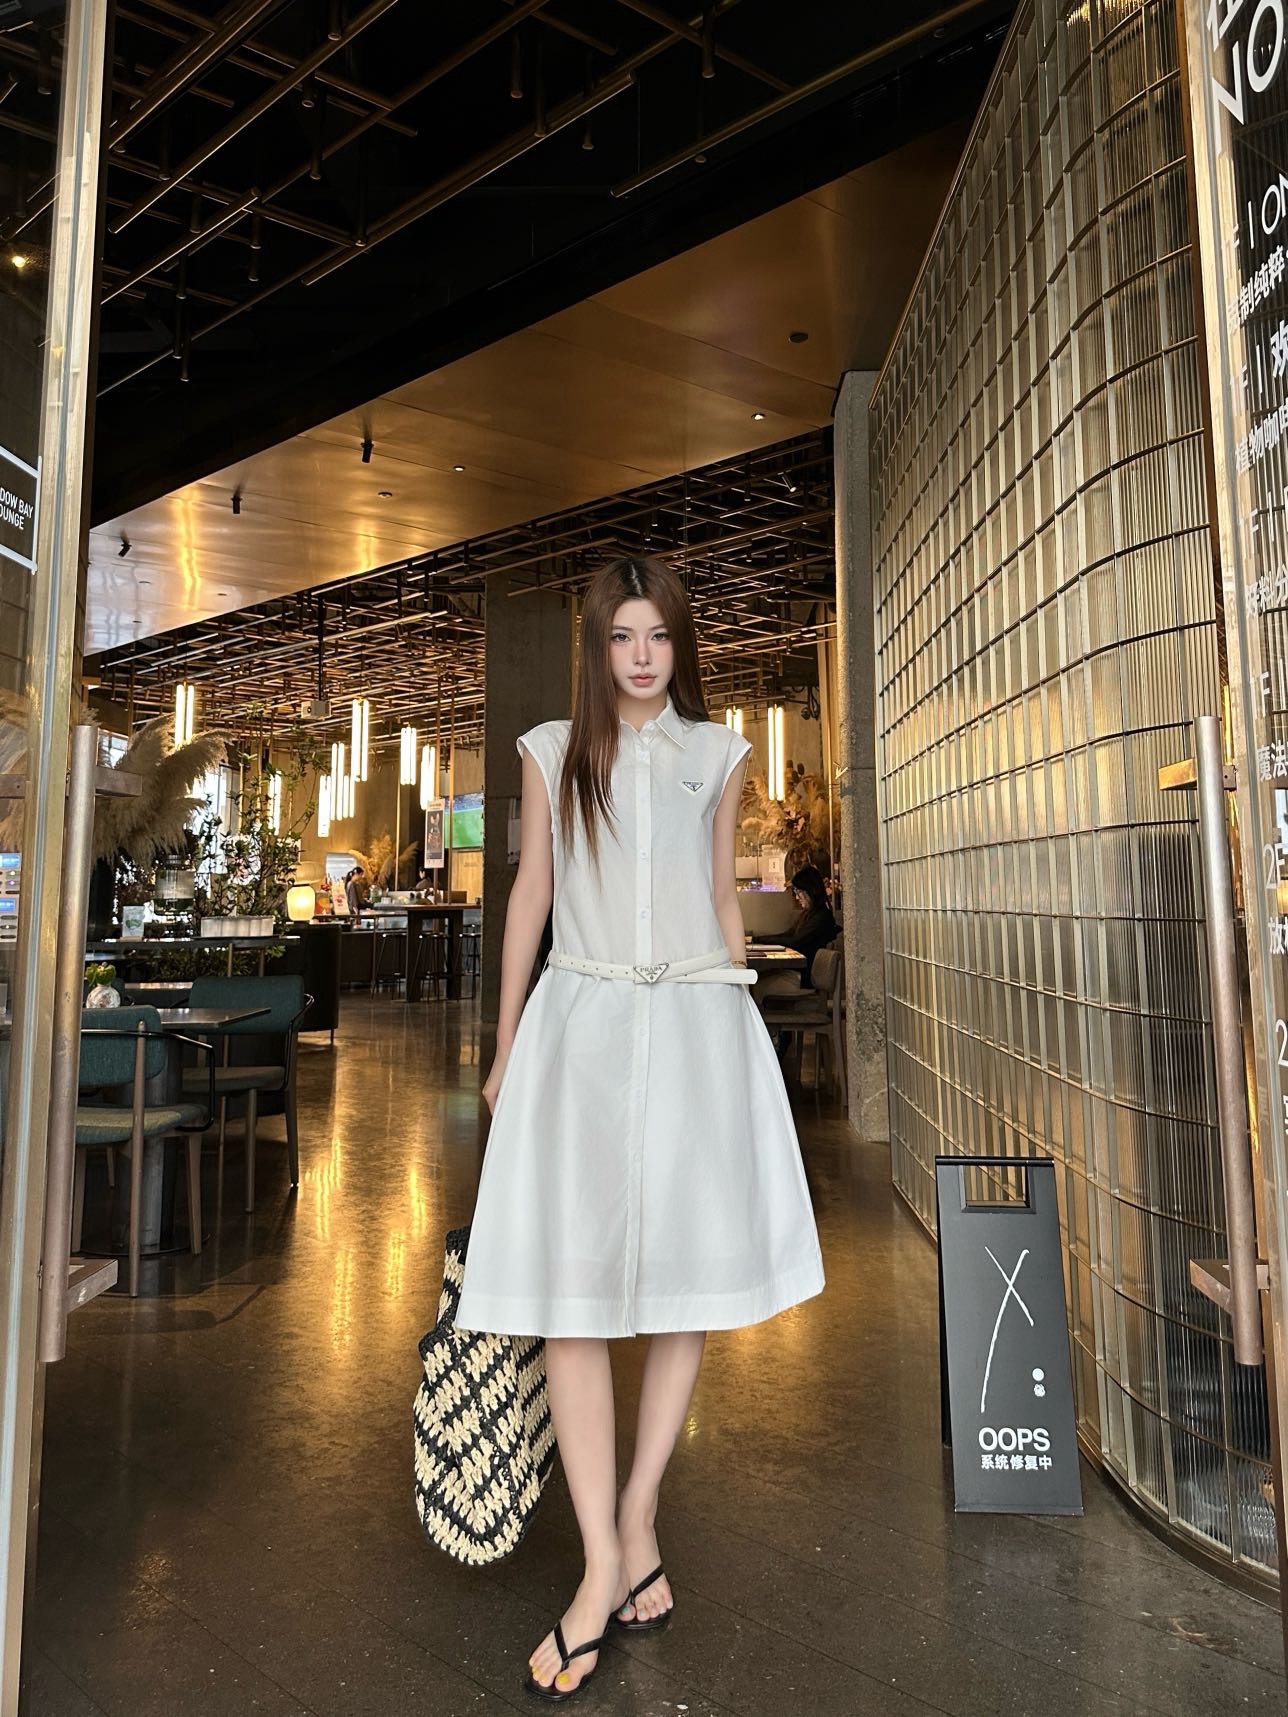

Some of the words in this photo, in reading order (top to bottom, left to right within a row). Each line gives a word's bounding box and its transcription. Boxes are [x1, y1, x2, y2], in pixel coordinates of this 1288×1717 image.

[19, 498, 33, 519] BAY
[1263, 842, 1286, 889] 2F
[979, 1427, 1051, 1451] OOPS
[981, 1454, 1053, 1470] 系统修复中
